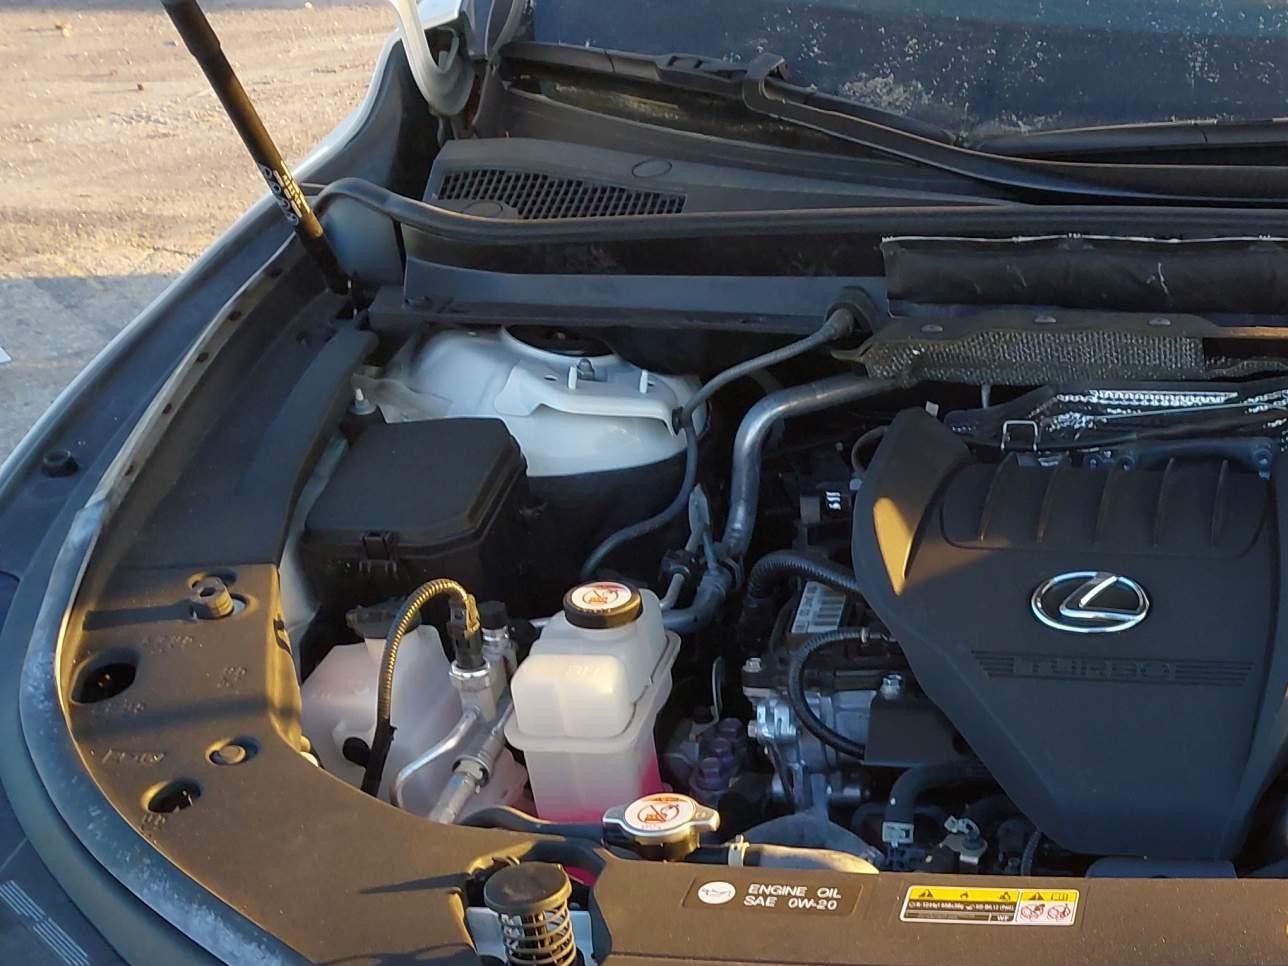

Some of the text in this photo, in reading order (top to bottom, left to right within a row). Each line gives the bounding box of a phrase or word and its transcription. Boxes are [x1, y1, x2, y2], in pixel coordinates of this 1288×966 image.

[748, 883, 842, 899] ENGINE OIL
[743, 895, 838, 910] SAE 0W-20
